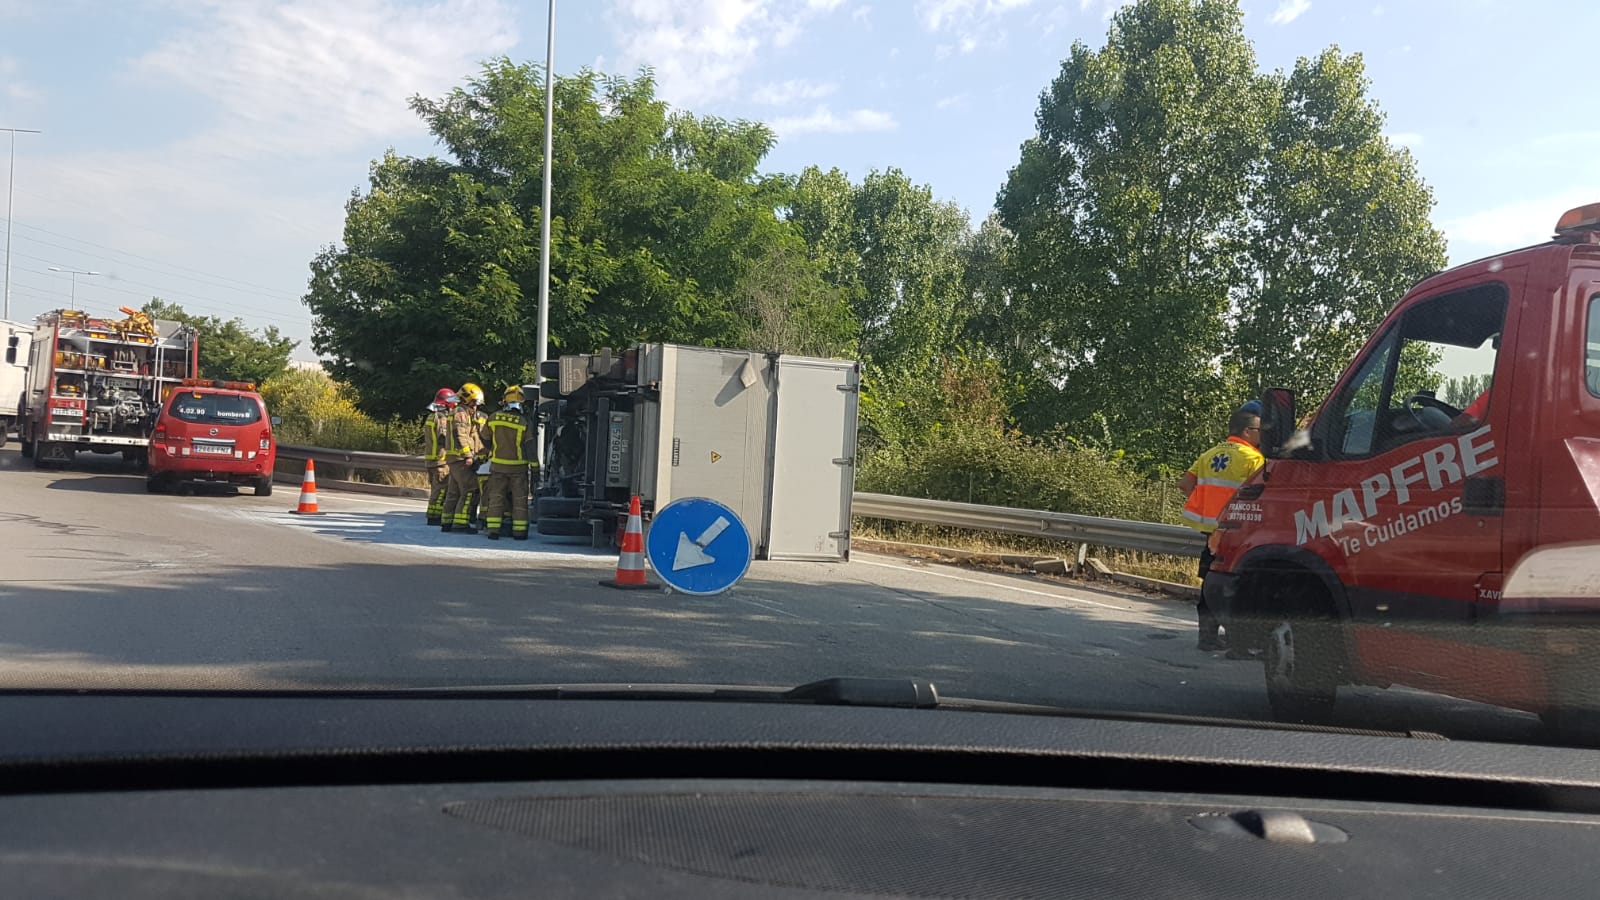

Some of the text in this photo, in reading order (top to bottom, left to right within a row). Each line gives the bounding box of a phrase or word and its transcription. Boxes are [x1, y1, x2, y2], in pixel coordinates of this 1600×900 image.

[1228, 503, 1250, 511] FRANCO
[1294, 424, 1499, 546] MAPFRE
[1339, 496, 1463, 557] Te Cuidamos
